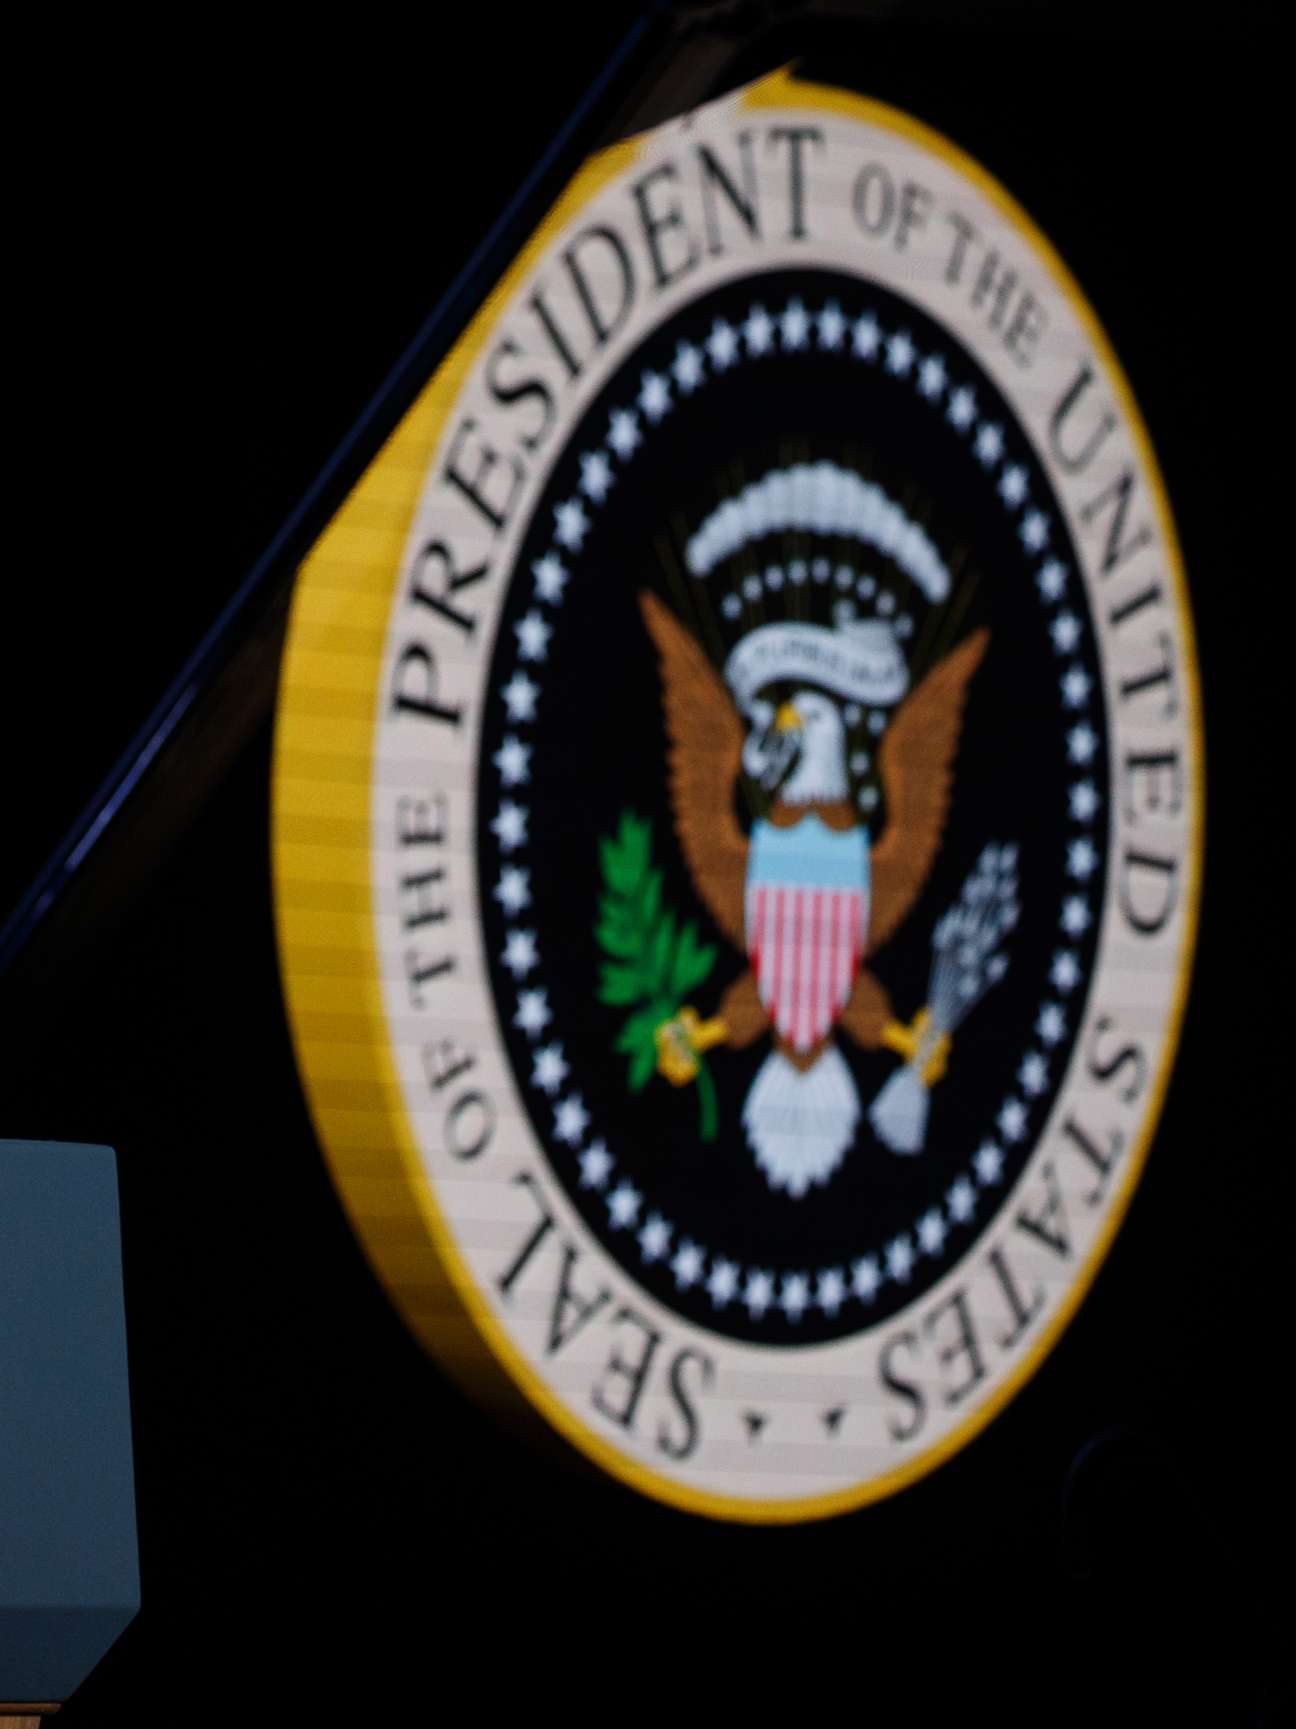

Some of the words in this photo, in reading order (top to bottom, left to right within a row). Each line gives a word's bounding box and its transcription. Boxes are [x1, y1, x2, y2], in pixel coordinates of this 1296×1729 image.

[851, 160, 934, 252] OF
[945, 210, 1050, 371] THE
[391, 126, 826, 733] PRESIDENT
[1048, 354, 1182, 935] UNITED
[396, 793, 459, 1010] THE
[421, 1033, 497, 1163] OF
[497, 1170, 715, 1462] SEAL
[877, 1015, 1149, 1443] STATES
